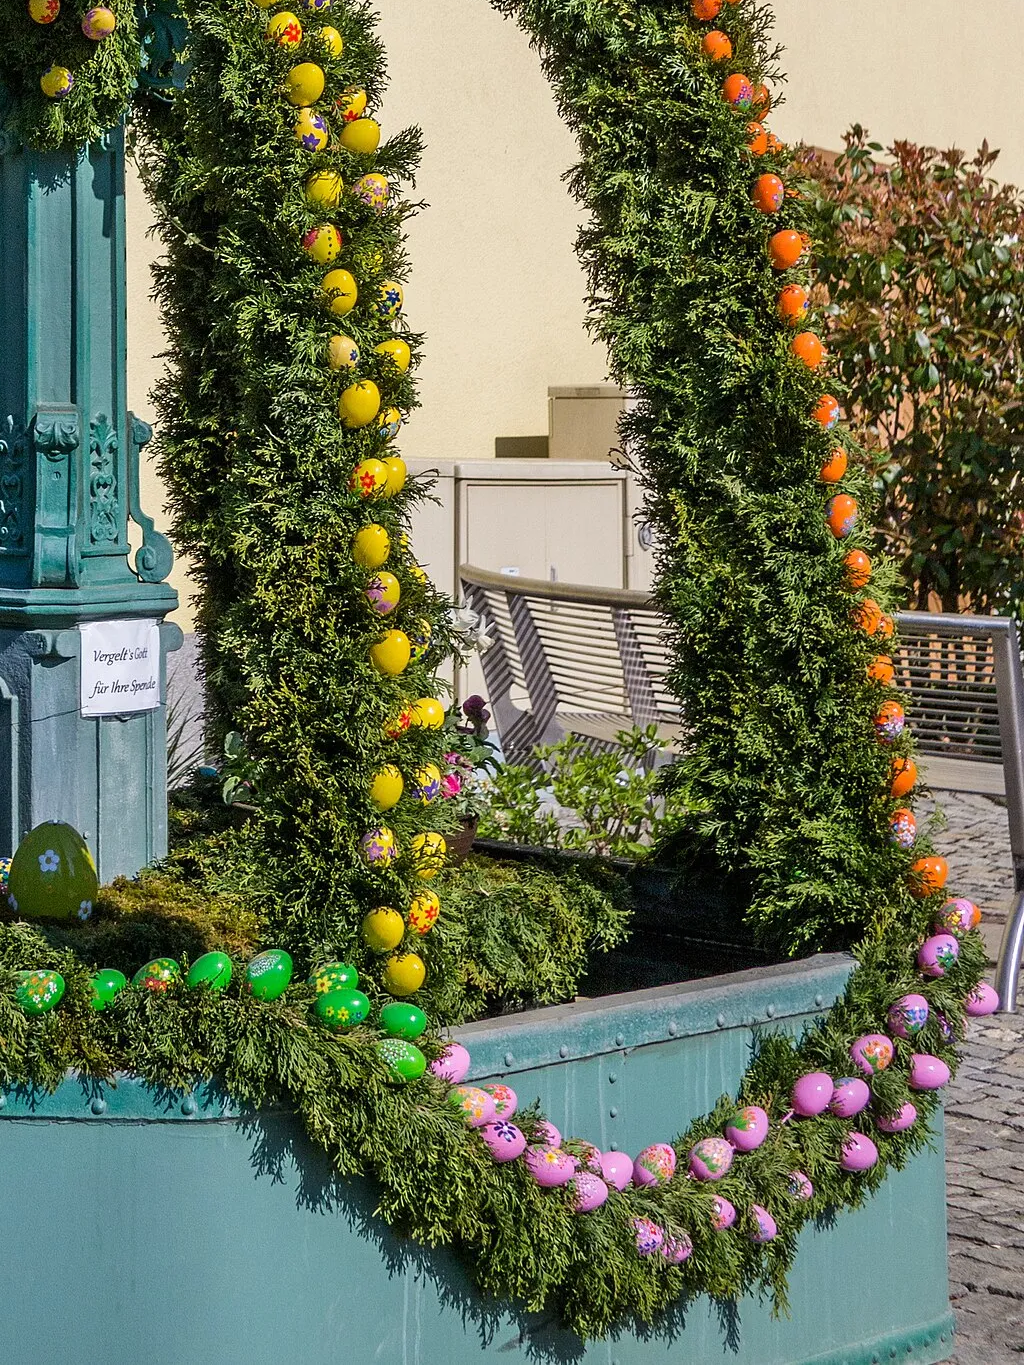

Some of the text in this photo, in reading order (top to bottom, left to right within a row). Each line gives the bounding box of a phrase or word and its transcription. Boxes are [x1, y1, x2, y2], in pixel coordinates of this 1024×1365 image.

[93, 647, 148, 666] Vergelt's Gott
[88, 676, 156, 699] für Ihre Spende
